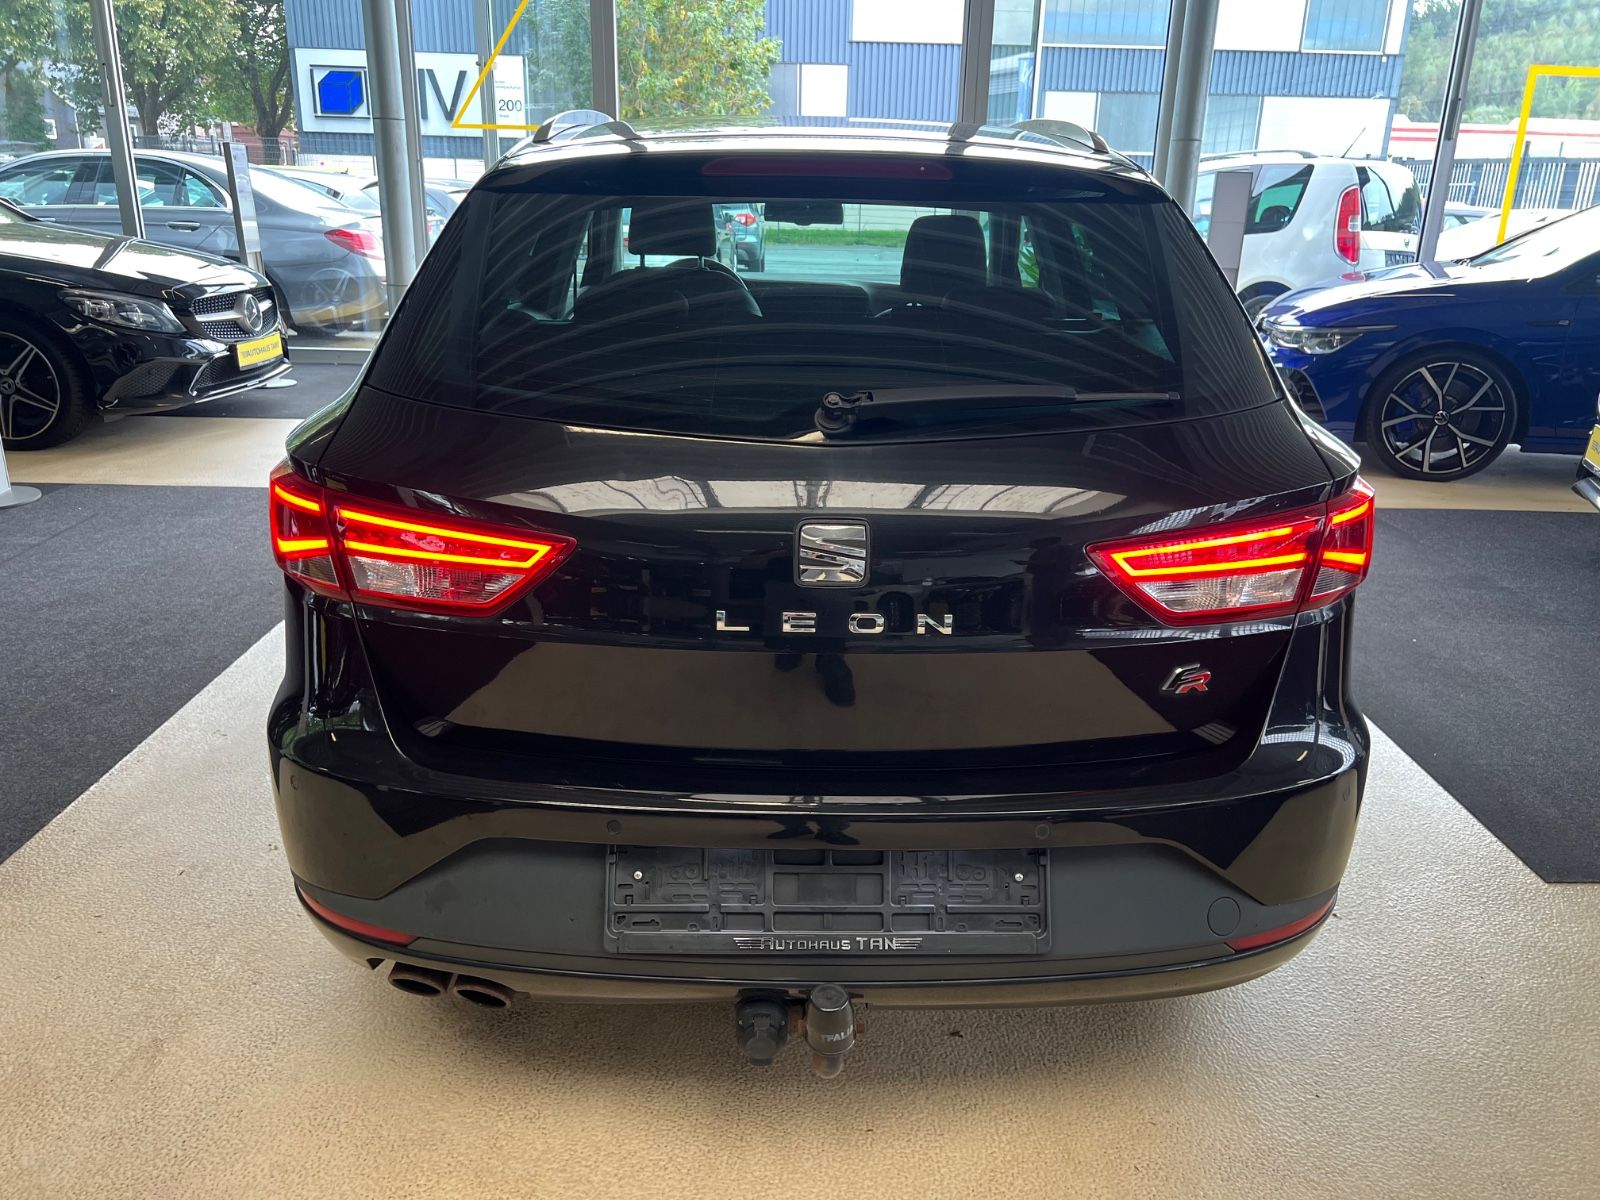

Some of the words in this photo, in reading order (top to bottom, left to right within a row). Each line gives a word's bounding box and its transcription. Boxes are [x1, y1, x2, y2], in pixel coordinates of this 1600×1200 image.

[498, 99, 523, 112] 200
[715, 610, 953, 635] LEON
[1161, 663, 1212, 695] FR
[760, 937, 851, 951] AUTOHAUS
[856, 937, 897, 951] TAN
